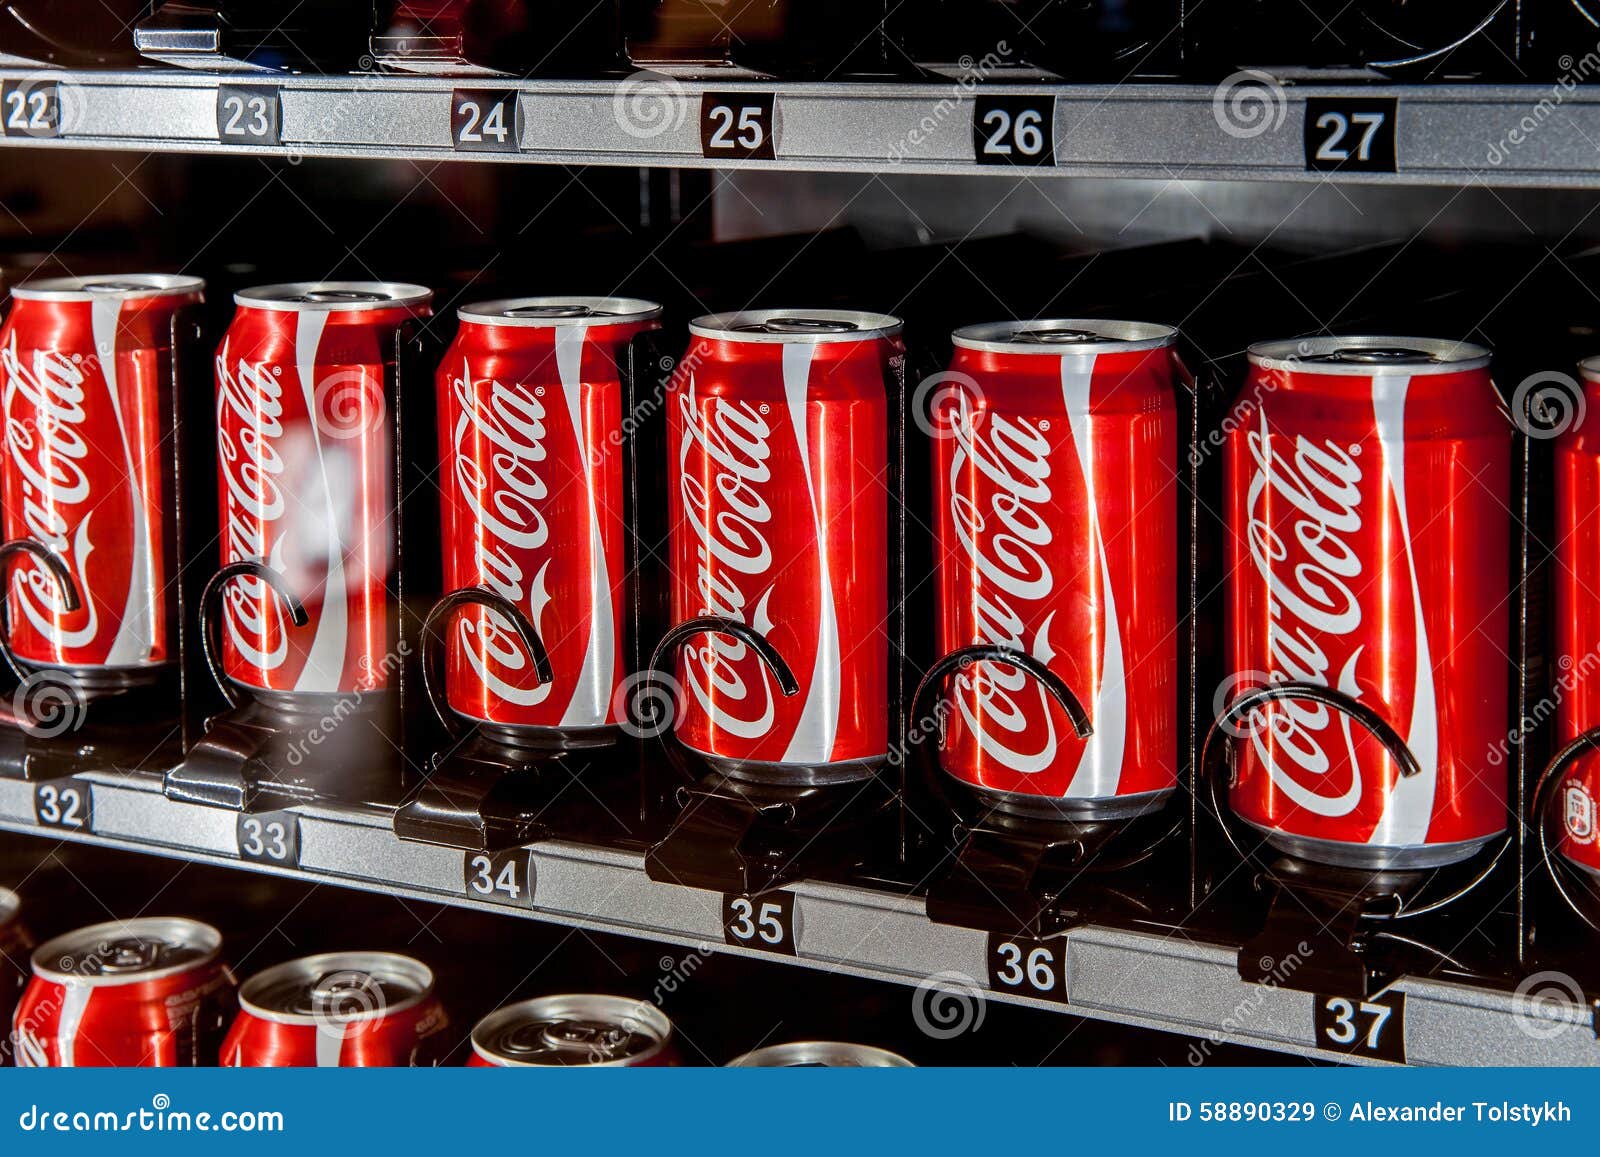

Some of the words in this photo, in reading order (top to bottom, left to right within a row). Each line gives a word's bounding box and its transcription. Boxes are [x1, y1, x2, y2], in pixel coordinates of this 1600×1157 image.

[7, 91, 49, 128] 22
[224, 96, 268, 136] 23
[457, 102, 508, 142] 24
[709, 107, 763, 149] 25
[983, 110, 1043, 155] 26
[1315, 113, 1385, 161] 27
[39, 785, 84, 826] 32
[243, 819, 288, 860] 33
[471, 856, 521, 898] 34
[730, 899, 783, 944] 35
[997, 943, 1056, 991] 36
[1325, 998, 1392, 1049] 37
